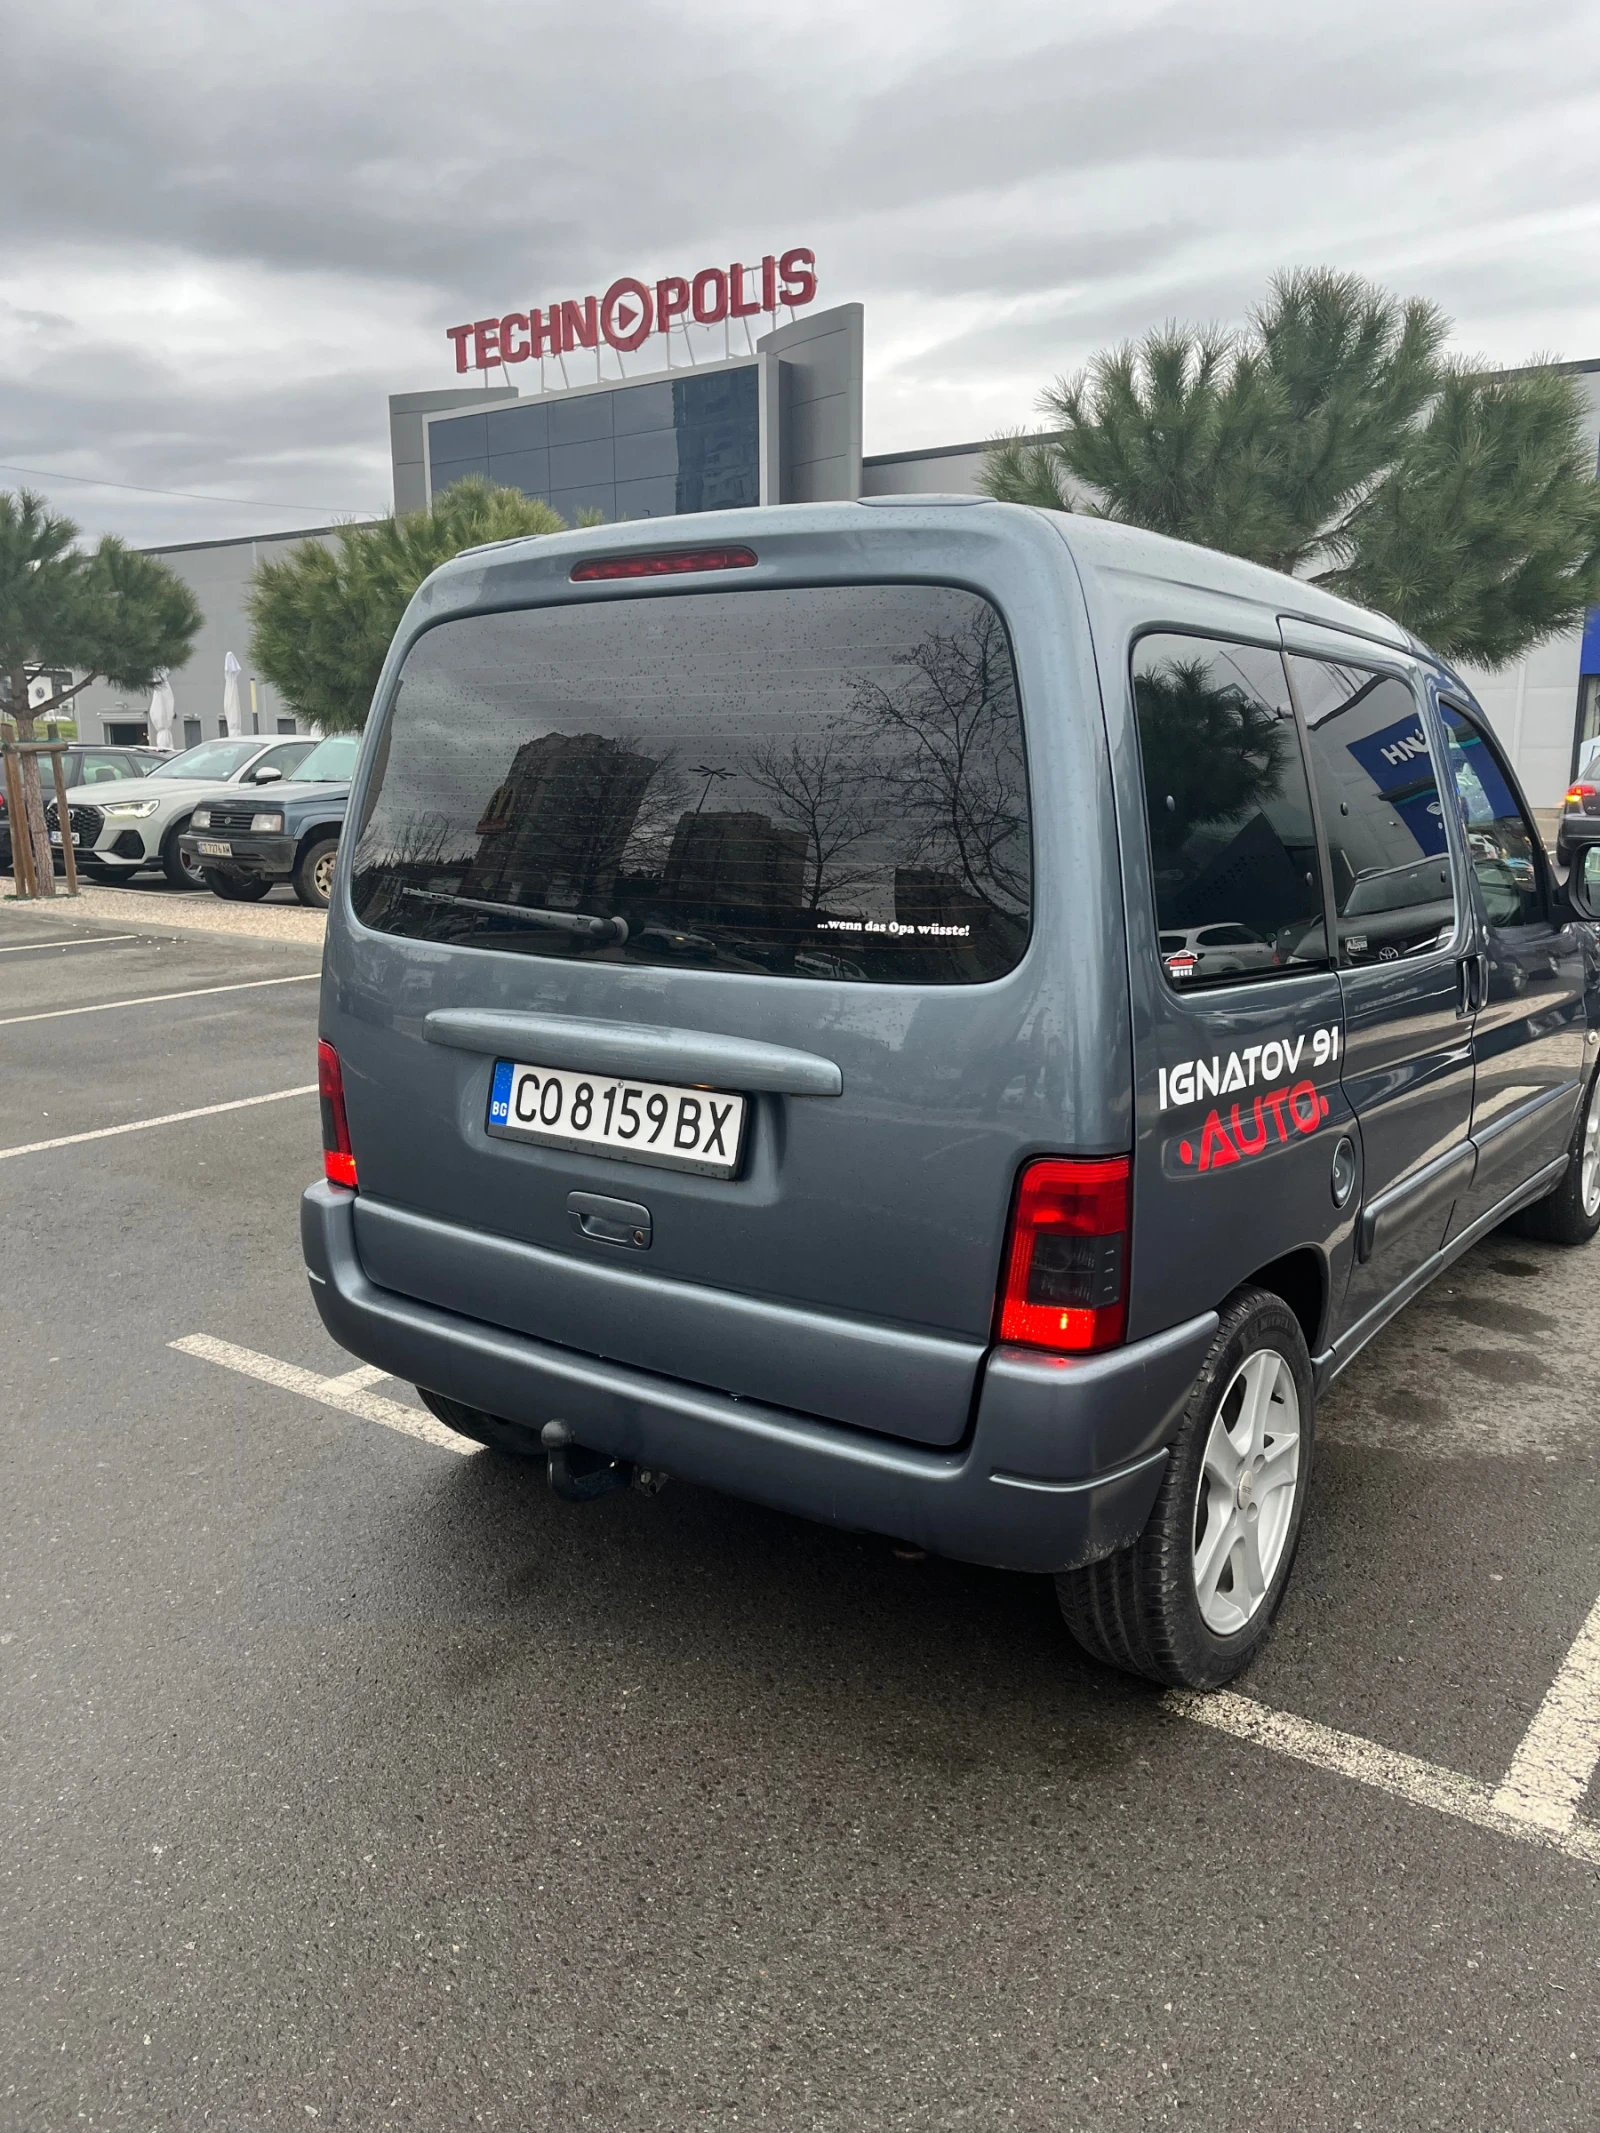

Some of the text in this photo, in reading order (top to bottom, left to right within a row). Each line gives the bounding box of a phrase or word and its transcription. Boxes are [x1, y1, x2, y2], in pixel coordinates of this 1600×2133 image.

[446, 247, 818, 374] TECHNOPOLIS
[865, 921, 886, 932] das
[888, 921, 915, 936] Opa
[917, 923, 970, 937] wüsste!
[492, 1101, 508, 1117] BG
[1158, 1026, 1339, 1111] IGNATOV 91
[1197, 1079, 1321, 1172] AUTO
